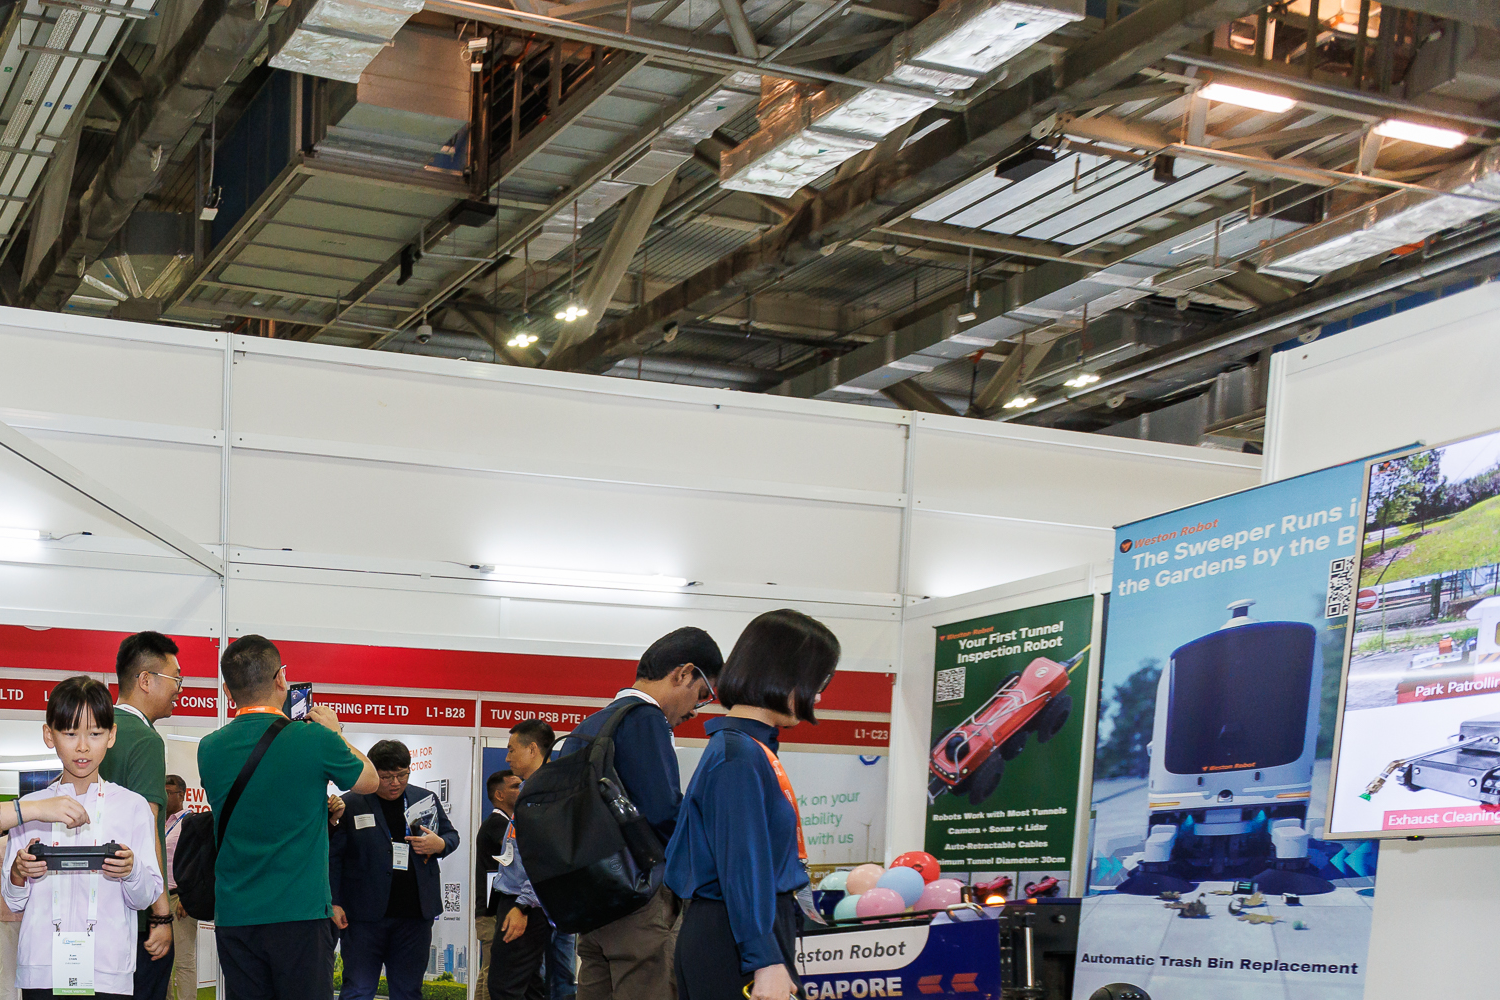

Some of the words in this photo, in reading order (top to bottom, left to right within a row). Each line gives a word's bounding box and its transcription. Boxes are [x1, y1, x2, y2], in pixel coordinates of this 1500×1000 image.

[1132, 550, 1169, 571] The
[1174, 522, 1275, 560] Sweeper
[1281, 503, 1343, 535] Runs
[1135, 530, 1177, 549] Weston
[1180, 519, 1219, 537] Robot
[1118, 577, 1150, 597] the
[1155, 554, 1247, 588] Gardens
[1252, 545, 1284, 567] by
[1289, 536, 1331, 557] the
[1337, 525, 1359, 547] B
[958, 637, 987, 650] Your
[989, 631, 1017, 645] First
[1019, 621, 1064, 639] Tunnel
[957, 645, 1021, 664] Inspection
[1024, 636, 1063, 652] Robot
[0, 689, 24, 701] LTD
[1415, 683, 1444, 697] Park
[313, 702, 362, 716] NEERING
[365, 703, 387, 716] PTE
[388, 705, 409, 717] LTD
[426, 706, 466, 719] L1-B28
[490, 708, 512, 720] TUV
[514, 710, 536, 721] SUD
[539, 712, 559, 723] PSB
[562, 713, 581, 724] PTE
[854, 729, 888, 740] L1-C23
[420, 747, 432, 757] FOR
[410, 760, 432, 772] CTORS
[186, 788, 205, 802] EW
[811, 795, 827, 806] on
[831, 792, 860, 808] your
[800, 812, 843, 828] ability
[932, 813, 962, 821] Robots
[963, 812, 985, 820] Work
[986, 810, 1005, 818] with
[1007, 809, 1030, 818] Most
[1032, 807, 1067, 816] Tunnels
[1388, 813, 1439, 826] Exhaust
[947, 827, 981, 835] Camera
[989, 826, 1015, 834] Sonar
[1025, 824, 1048, 832] Lidar
[808, 833, 834, 845] with
[838, 833, 854, 844] us
[944, 841, 1016, 850] Auto-Retractable
[1018, 840, 1048, 848] Cables
[937, 857, 965, 866] nimum
[966, 857, 994, 865] Tunnel
[995, 857, 1039, 865] Diameter:
[1041, 856, 1065, 864] 30cm
[796, 948, 843, 963] eston
[850, 941, 906, 959] Robot
[1081, 953, 1155, 967] Automatic
[1159, 955, 1202, 968] Trash
[1207, 957, 1234, 970] Bin
[1240, 958, 1359, 975] Replacement
[804, 977, 903, 1000] GAPORE
